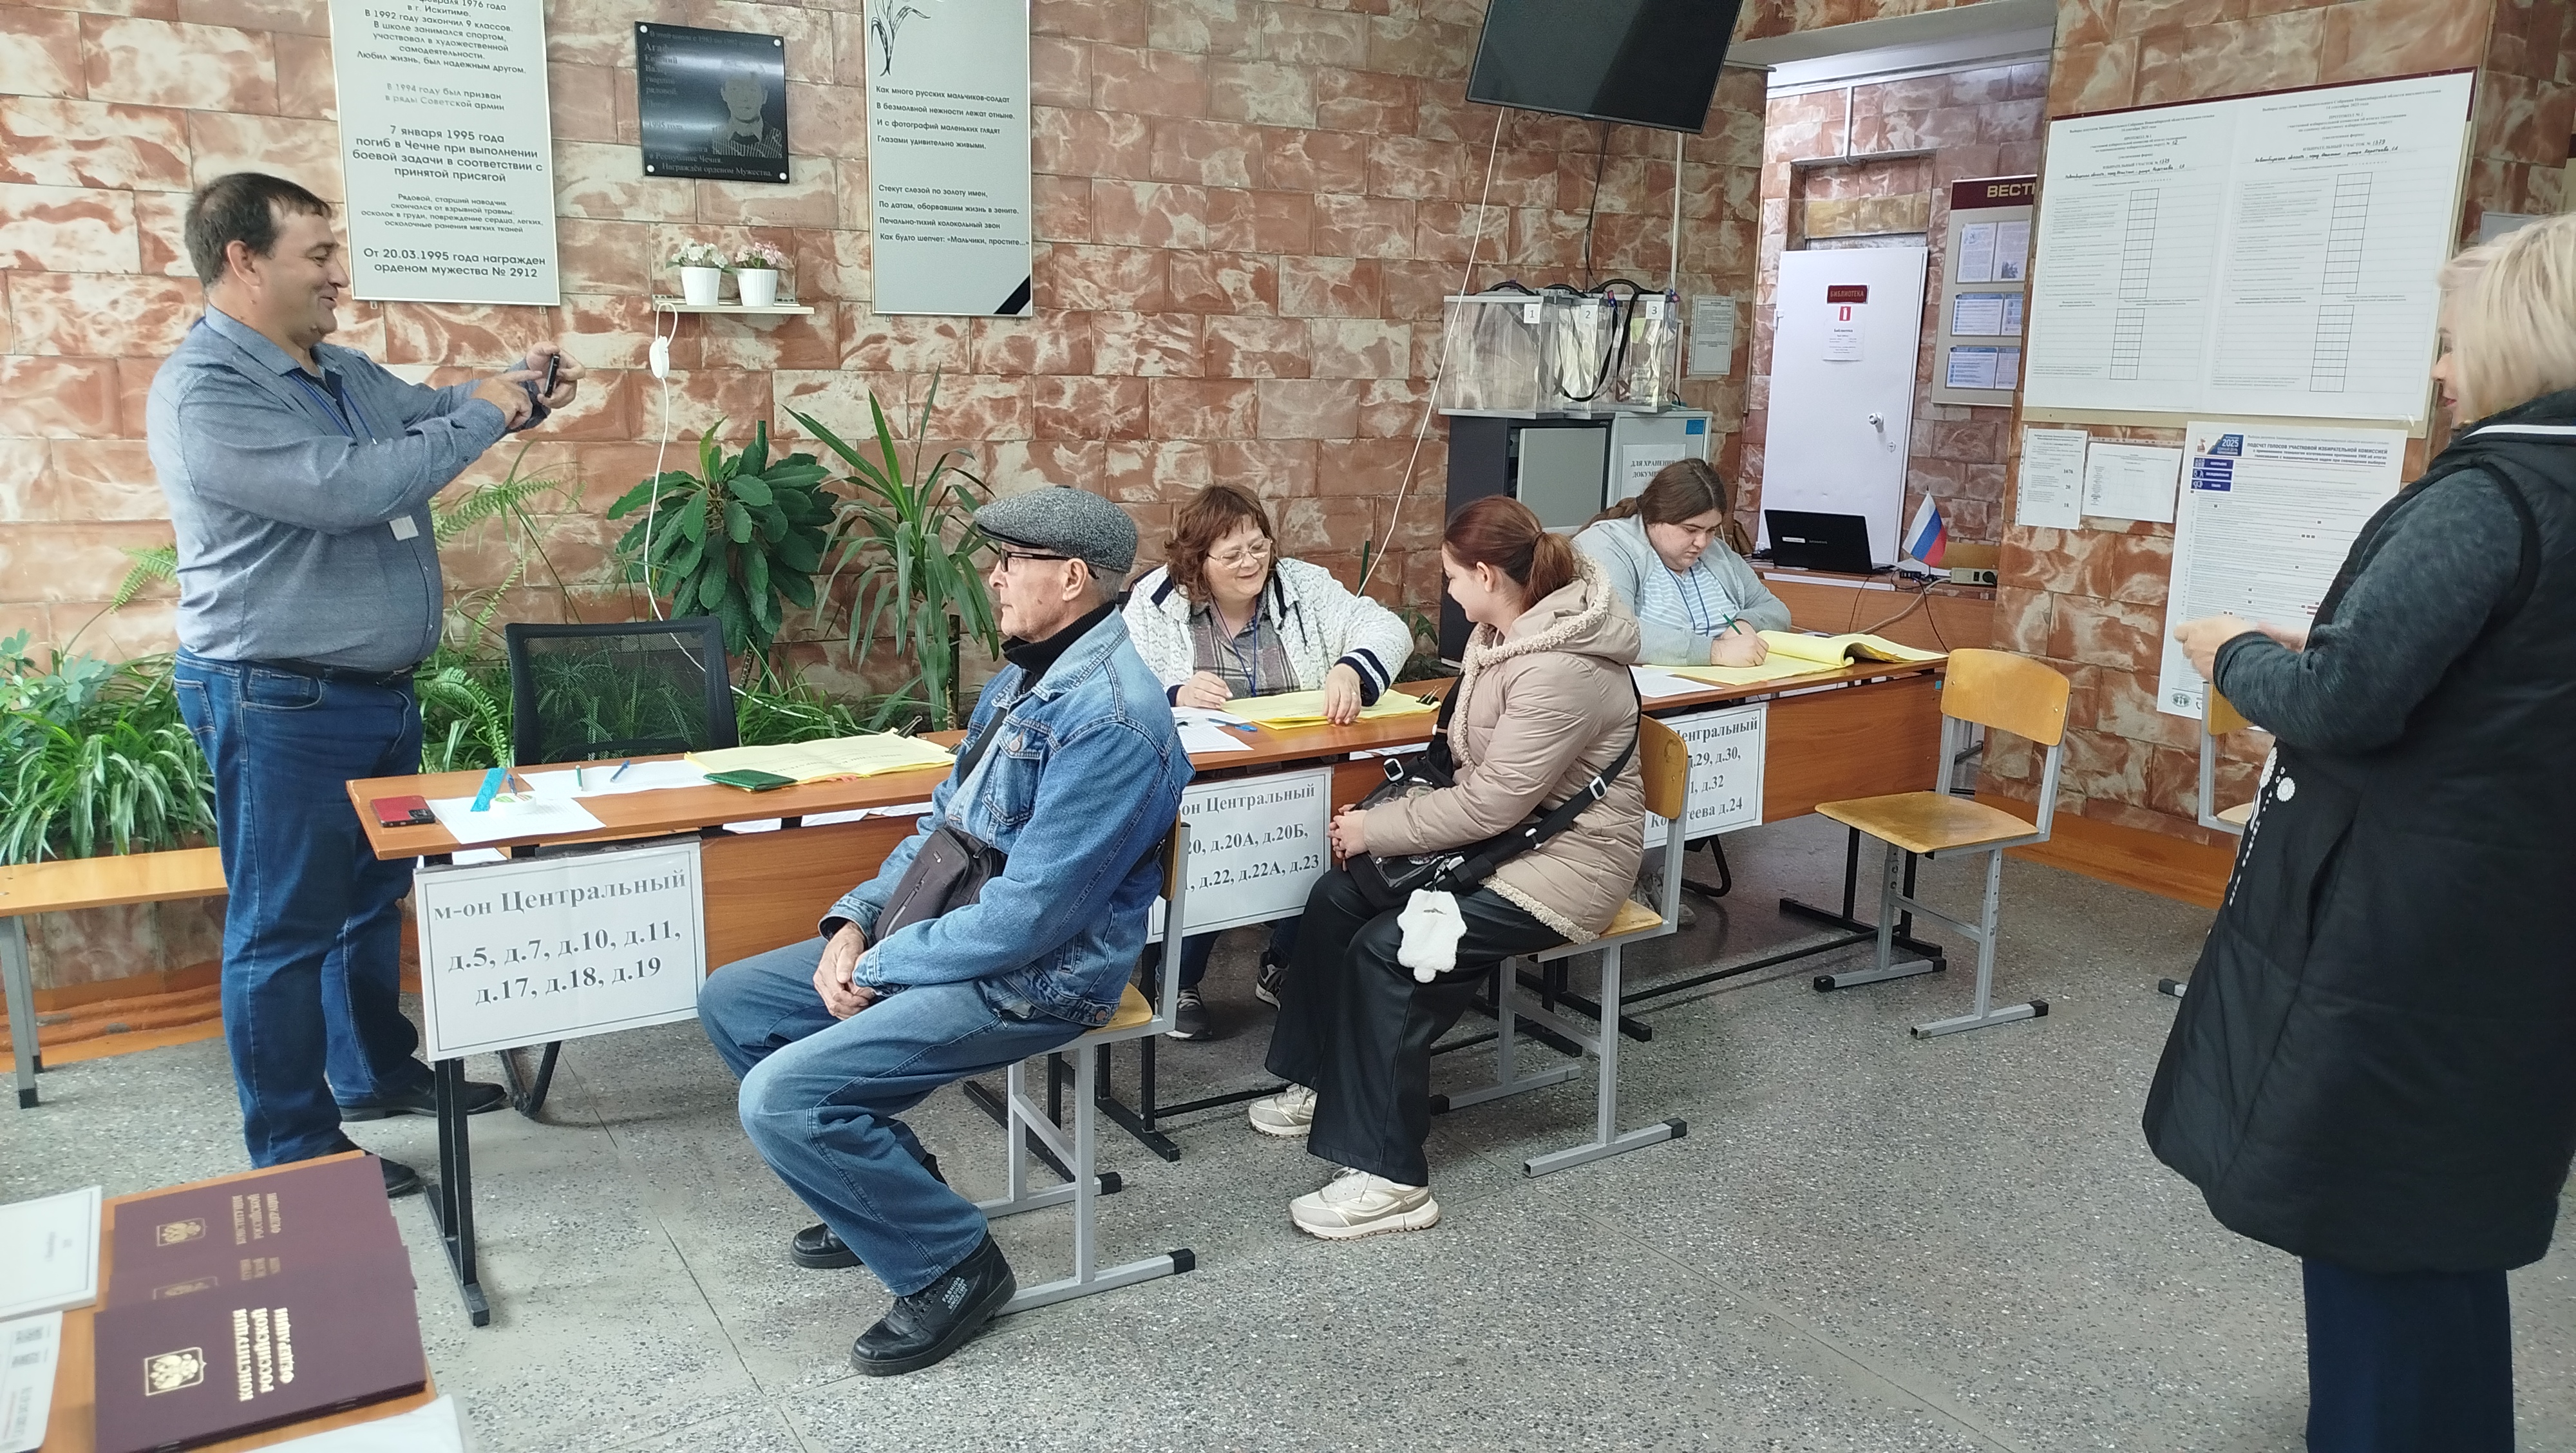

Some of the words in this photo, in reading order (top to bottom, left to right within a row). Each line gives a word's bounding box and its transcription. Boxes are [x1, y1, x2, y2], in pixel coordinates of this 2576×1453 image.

[425, 5, 471, 17] Искитиме.
[374, 10, 396, 20] 1992
[399, 15, 419, 23] году
[422, 17, 463, 26] закончил
[475, 23, 513, 32] классов.
[374, 20, 379, 28] В
[415, 26, 463, 37] занимался
[466, 32, 506, 42] спортом,
[373, 32, 425, 43] участвовал
[436, 39, 508, 52] художественной
[399, 46, 485, 59] самодеятельности.
[357, 51, 387, 61] Любил
[390, 55, 421, 64] жизнь,
[424, 57, 440, 66] был
[444, 60, 490, 70] надежным
[493, 65, 526, 74] другом.
[396, 83, 416, 92] 1994
[419, 87, 440, 96] году
[443, 88, 461, 96] был
[464, 91, 501, 100] призван
[947, 93, 1009, 104] мальчиков-солдат
[421, 96, 471, 108] Советской
[475, 102, 504, 111] армии
[884, 102, 927, 113] безмолвной
[390, 125, 396, 135] 7
[401, 128, 442, 140] января
[448, 129, 475, 140] 1995
[479, 134, 504, 144] года
[892, 120, 938, 131] фотографий
[941, 124, 978, 133] маленьких
[356, 138, 390, 147] погиб
[404, 139, 440, 151] Чечне
[444, 144, 465, 155] при
[469, 146, 537, 158] выполнении
[878, 135, 908, 144] Глазами
[353, 149, 397, 162] боевой
[402, 155, 443, 165] задачи
[457, 159, 532, 171] соответствии
[395, 167, 448, 178] принятой
[453, 172, 506, 182] присягой
[704, 166, 734, 175] орденом
[878, 184, 902, 194] Стекут
[917, 202, 963, 212] оборвавшим
[880, 217, 936, 226] Печально-тихий
[895, 233, 915, 242] будто
[947, 235, 987, 245] «Мальчики,
[988, 238, 1029, 246] простите...»
[364, 248, 379, 258] От
[383, 249, 449, 261] 20.03.1995
[453, 254, 478, 263] года
[483, 255, 545, 266] награжден
[374, 264, 428, 274] орденом
[432, 267, 488, 276] мужества
[493, 267, 506, 276] №
[510, 268, 537, 278] 2912
[1530, 310, 1535, 319] 1
[1586, 310, 1591, 319] 2
[1652, 306, 1658, 315] 3
[2222, 439, 2239, 447] 2025
[1716, 746, 1741, 763] д.30,
[1701, 775, 1725, 793] д.32
[1206, 783, 1315, 814] Центральный
[1718, 797, 1743, 815] д.24
[1210, 832, 1259, 853] д.20А,
[1262, 823, 1309, 846] д.20Б,
[1198, 869, 1235, 890] д.22,
[1238, 861, 1286, 882] д.22А,
[1289, 854, 1320, 875] д.23
[434, 902, 491, 920] м-он
[502, 869, 687, 914] Центральный
[449, 947, 495, 973] д.5,
[504, 939, 549, 965] д.7,
[558, 929, 616, 958] д.10,
[624, 920, 680, 947] д.11,
[476, 978, 537, 1006] д.17,
[545, 967, 603, 995] д.18,
[612, 957, 661, 985] д.19
[942, 1276, 961, 1303] FASHION
[947, 1293, 960, 1310] SINCE
[251, 1307, 275, 1394] РОССИЙСКОЙ
[274, 1307, 295, 1384] ФЕДЕРАЦИИ
[232, 1308, 254, 1402] КОНСТИТУЦИЯ
